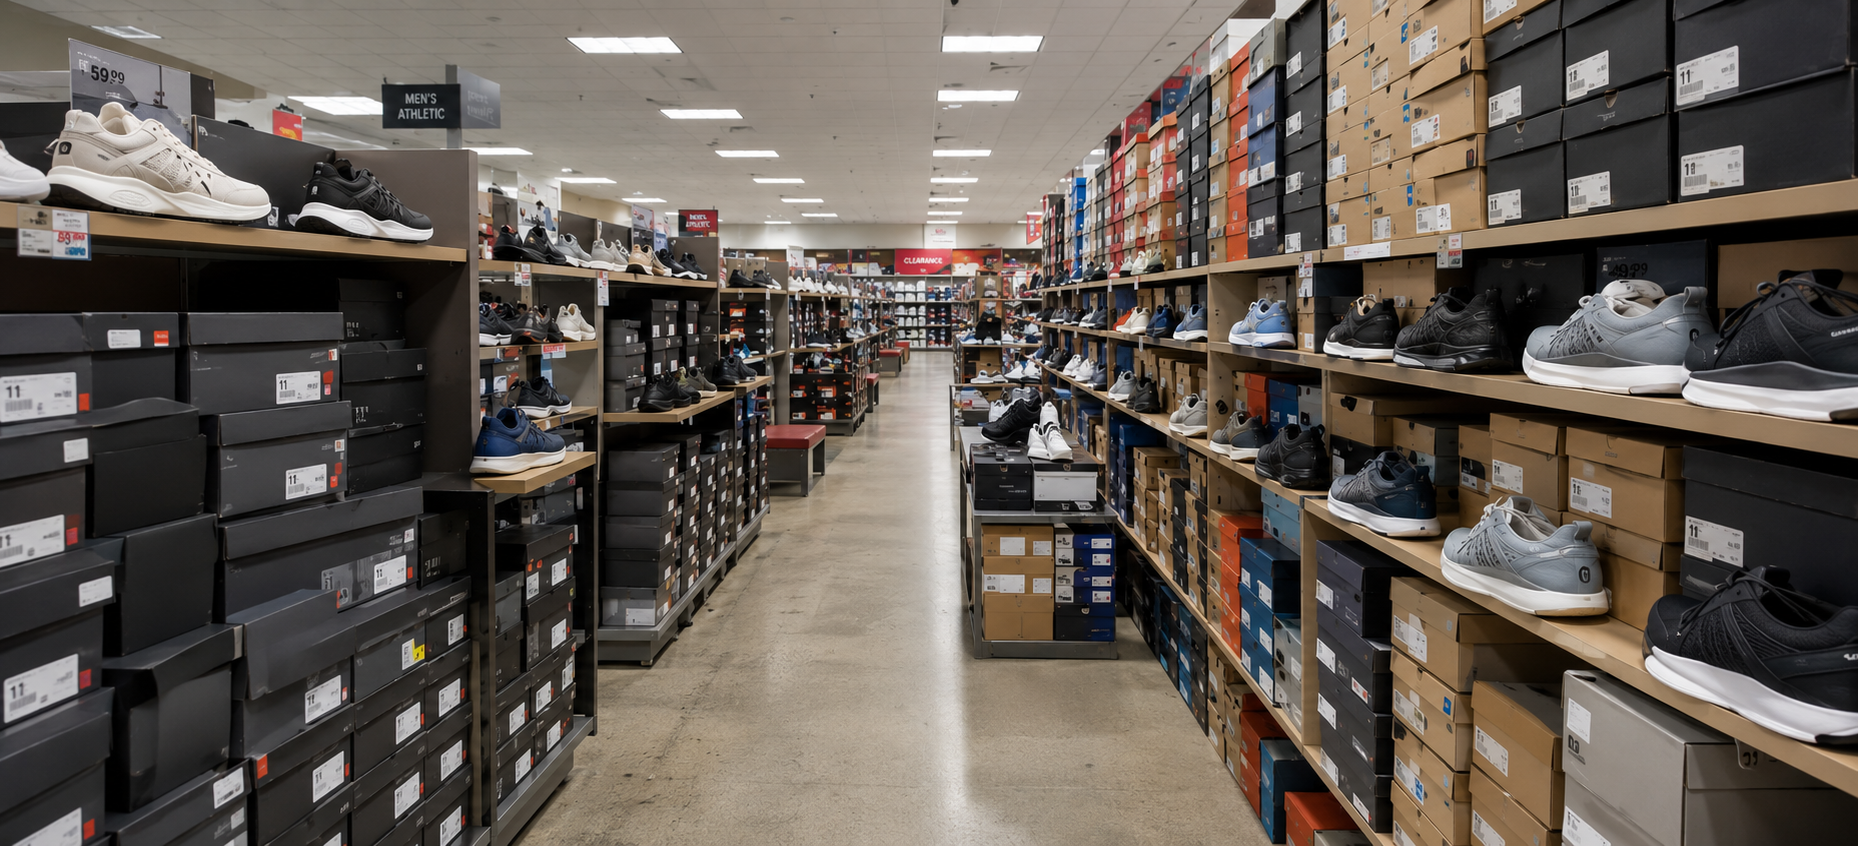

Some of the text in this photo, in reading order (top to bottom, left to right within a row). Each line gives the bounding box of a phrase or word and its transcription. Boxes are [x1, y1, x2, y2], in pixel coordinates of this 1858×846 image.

[1679, 69, 1691, 85] 11
[405, 93, 437, 105] MEN'S
[397, 108, 446, 120] ATHLETIC
[279, 379, 287, 390] 11
[5, 385, 21, 398] 11
[288, 474, 297, 485] 11
[1688, 524, 1699, 538] 11
[10, 681, 25, 699] 11
